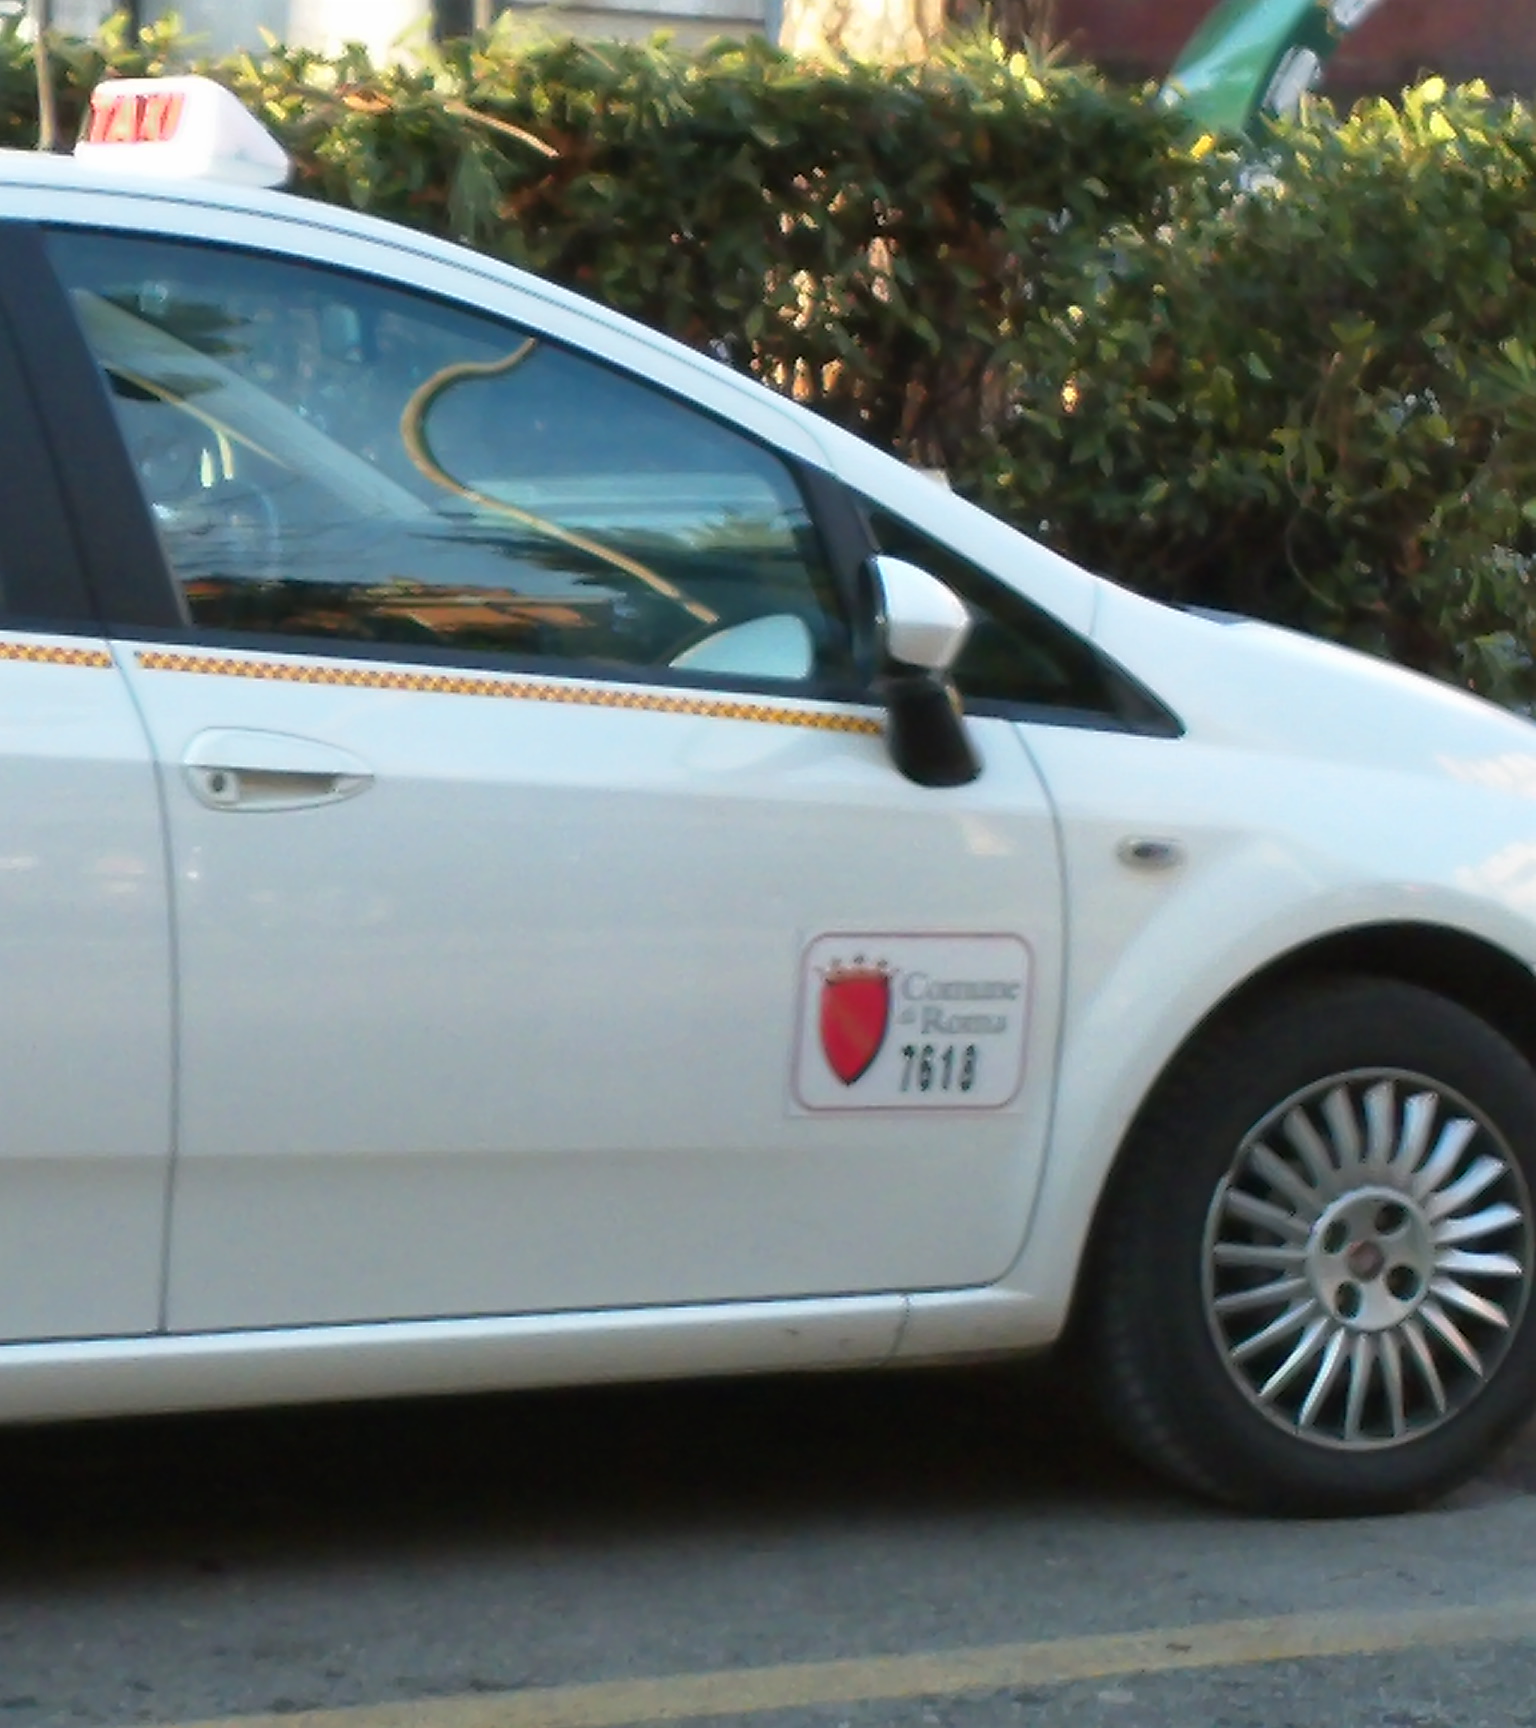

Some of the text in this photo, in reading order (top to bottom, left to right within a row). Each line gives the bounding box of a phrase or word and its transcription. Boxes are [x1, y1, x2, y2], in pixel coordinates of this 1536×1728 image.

[89, 92, 186, 143] TAXI
[920, 1005, 1007, 1035] Roma
[900, 1044, 977, 1092] 7618
